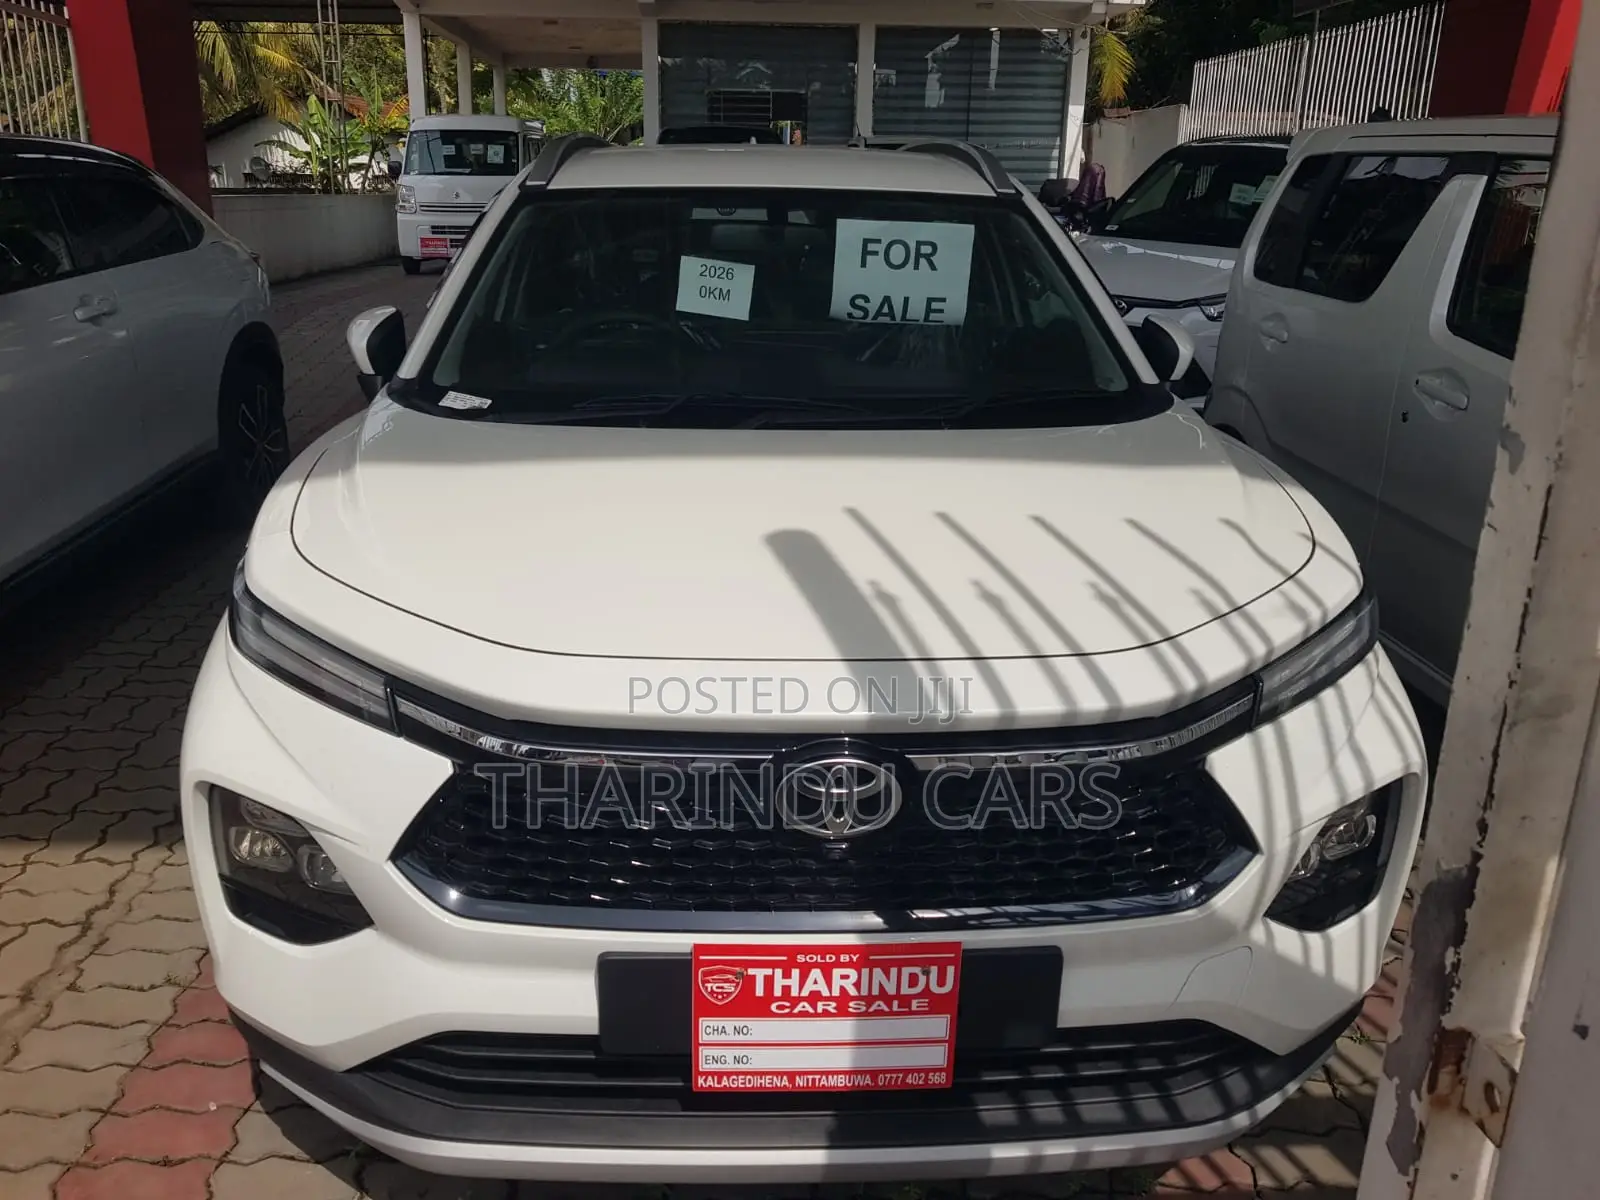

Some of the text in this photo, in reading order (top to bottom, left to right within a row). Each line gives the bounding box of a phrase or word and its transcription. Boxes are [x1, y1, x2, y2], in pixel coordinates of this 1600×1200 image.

[859, 238, 939, 272] FOR
[699, 263, 735, 281] 2026
[698, 285, 732, 302] 0KM
[846, 293, 948, 324] SALE
[796, 953, 860, 963] SOLD BY
[704, 983, 737, 993] TCS
[747, 965, 955, 997] THARINDU
[770, 998, 930, 1014] CAR SALE
[704, 1025, 753, 1036] CHA. NO:
[704, 1054, 753, 1065] ENG. NO:
[697, 1075, 793, 1089] KALAGEDIHENA,
[878, 1073, 902, 1086] 0777
[906, 1072, 925, 1085] 402
[927, 1071, 947, 1085] 568
